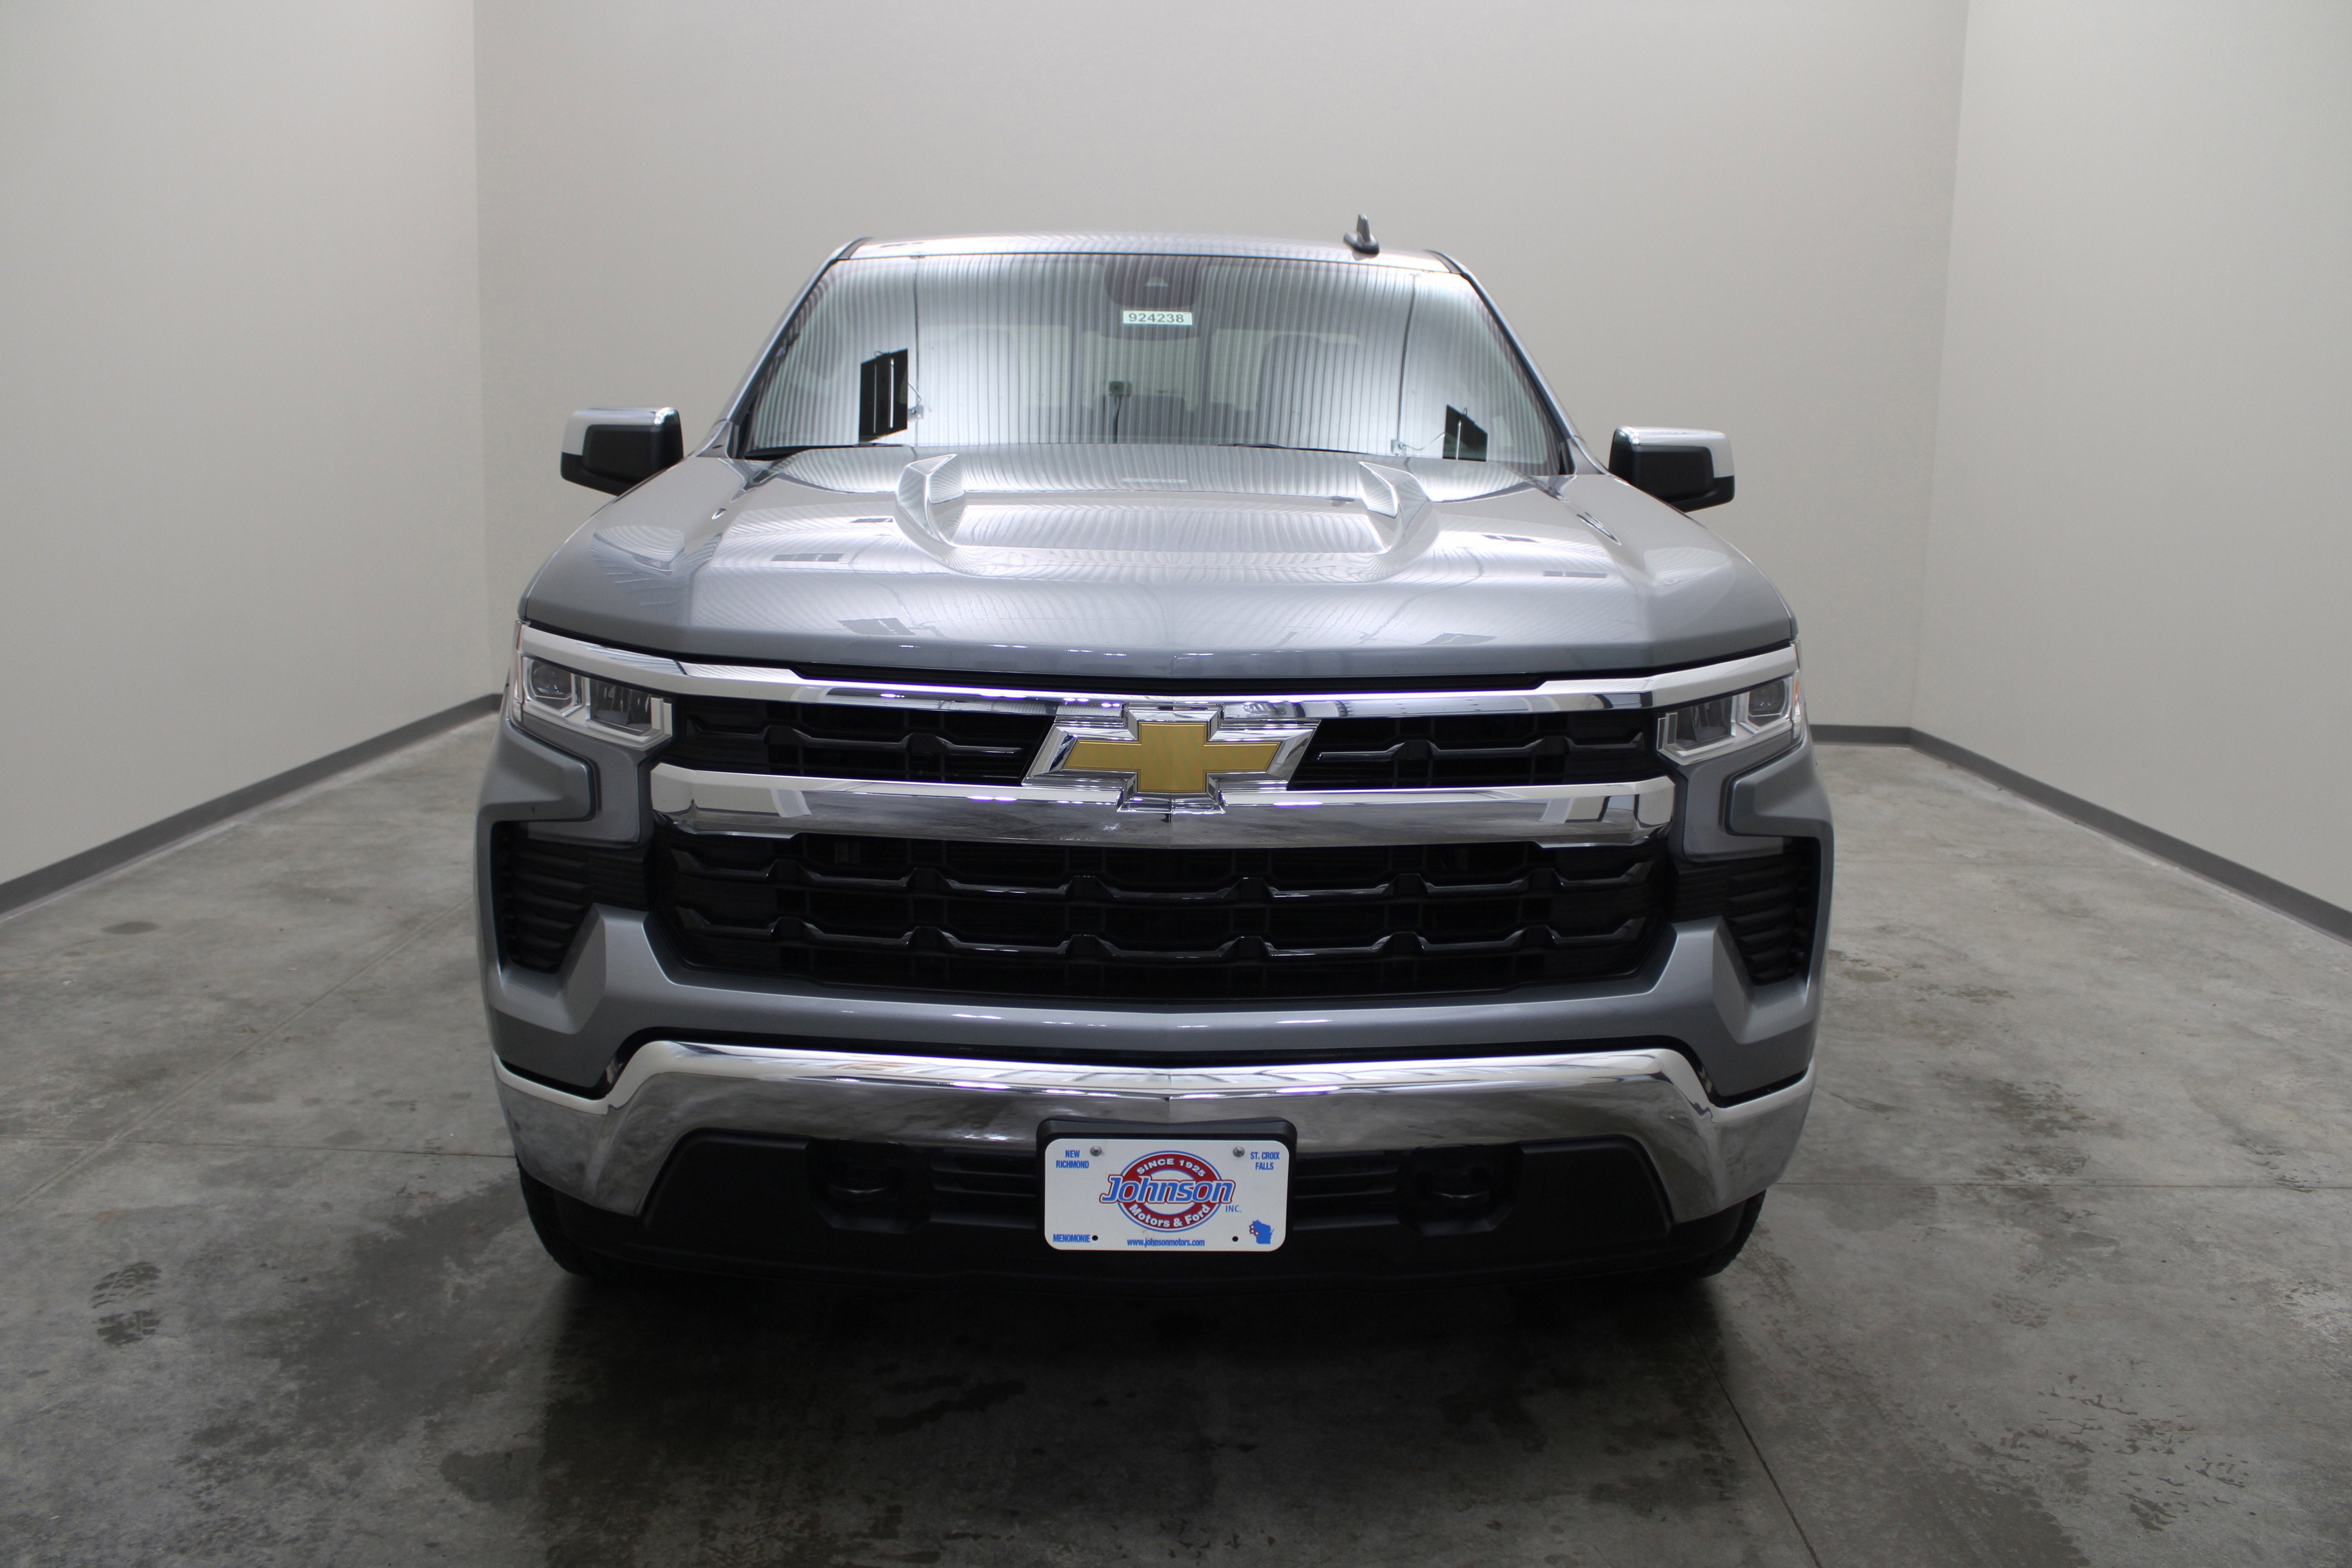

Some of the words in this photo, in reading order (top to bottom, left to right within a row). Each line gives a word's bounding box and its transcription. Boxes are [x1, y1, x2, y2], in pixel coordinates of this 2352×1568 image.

[1129, 312, 1184, 323] 924238
[1065, 1150, 1080, 1158] NEW
[1262, 1152, 1280, 1160] CROIX
[1056, 1160, 1089, 1169] RICHMOND
[1137, 1158, 1174, 1175] SINCE
[1179, 1160, 1206, 1177] 1925
[1255, 1162, 1274, 1170] FALLS
[1100, 1175, 1235, 1203] Johnson
[1129, 1204, 1170, 1227] Motors
[1173, 1218, 1183, 1227] &
[1185, 1204, 1211, 1225] Ford
[1053, 1234, 1091, 1243] MENOMONIE
[1127, 1238, 1205, 1247] www.johnsonmotors.com
